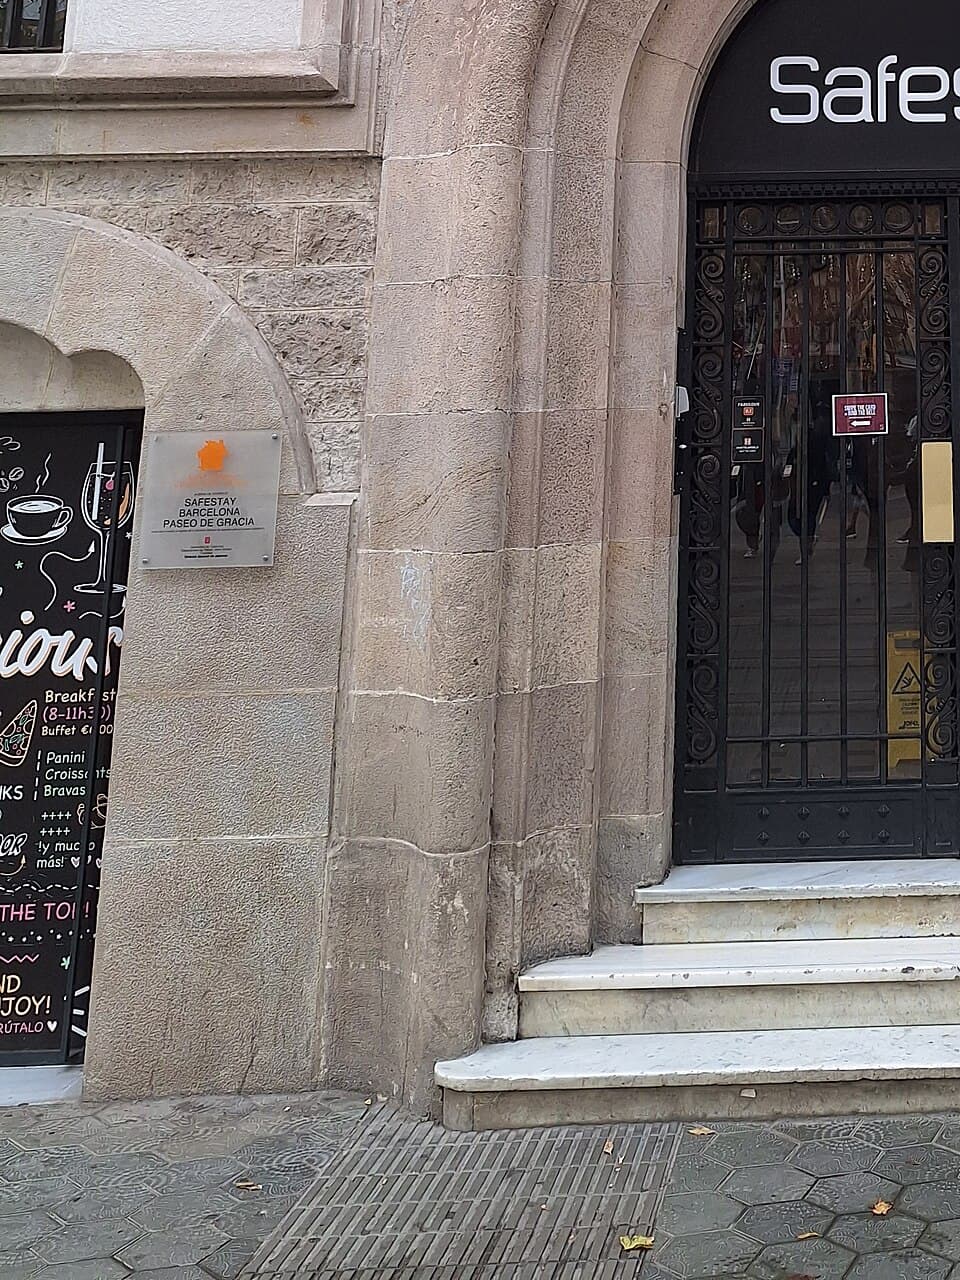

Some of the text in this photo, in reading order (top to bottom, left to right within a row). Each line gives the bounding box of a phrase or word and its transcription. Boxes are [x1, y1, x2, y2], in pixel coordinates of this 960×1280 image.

[184, 497, 237, 507] SAFESTAY
[179, 507, 241, 517] BARCELONA
[163, 517, 255, 528] PASEO DE GRACIA
[45, 688, 117, 703] Breakfst
[41, 725, 77, 736] Buffet
[46, 751, 86, 764] Panini
[44, 784, 86, 797] Bravas
[55, 841, 95, 852] muco
[36, 855, 65, 868] más!
[0, 903, 36, 921] THE
[0, 995, 51, 1017] JOY!
